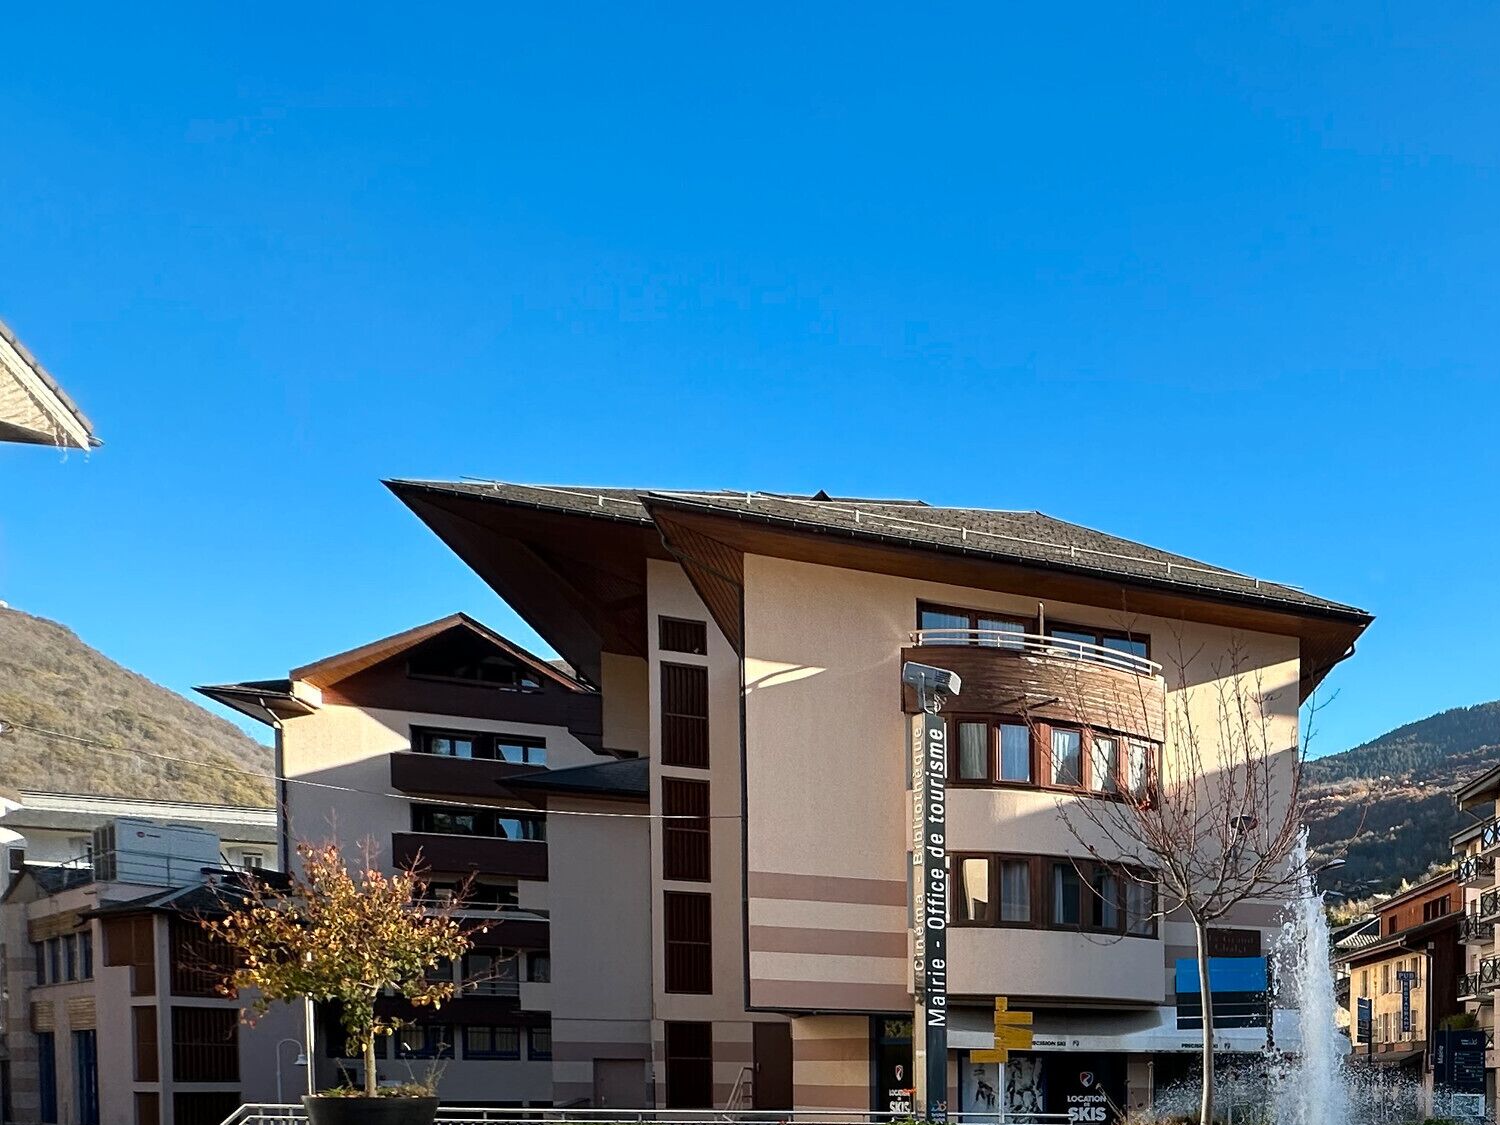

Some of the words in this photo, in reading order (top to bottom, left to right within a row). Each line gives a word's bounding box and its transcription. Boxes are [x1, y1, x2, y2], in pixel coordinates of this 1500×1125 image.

[912, 727, 924, 866] Bibliothèque
[925, 728, 944, 823] tourisme
[927, 833, 945, 858] de
[926, 867, 945, 930] Office
[913, 893, 925, 971] Cinéma
[927, 958, 945, 1026] Mairie
[1066, 1095, 1106, 1103] LOCATION
[1067, 1106, 1107, 1121] SKIS
